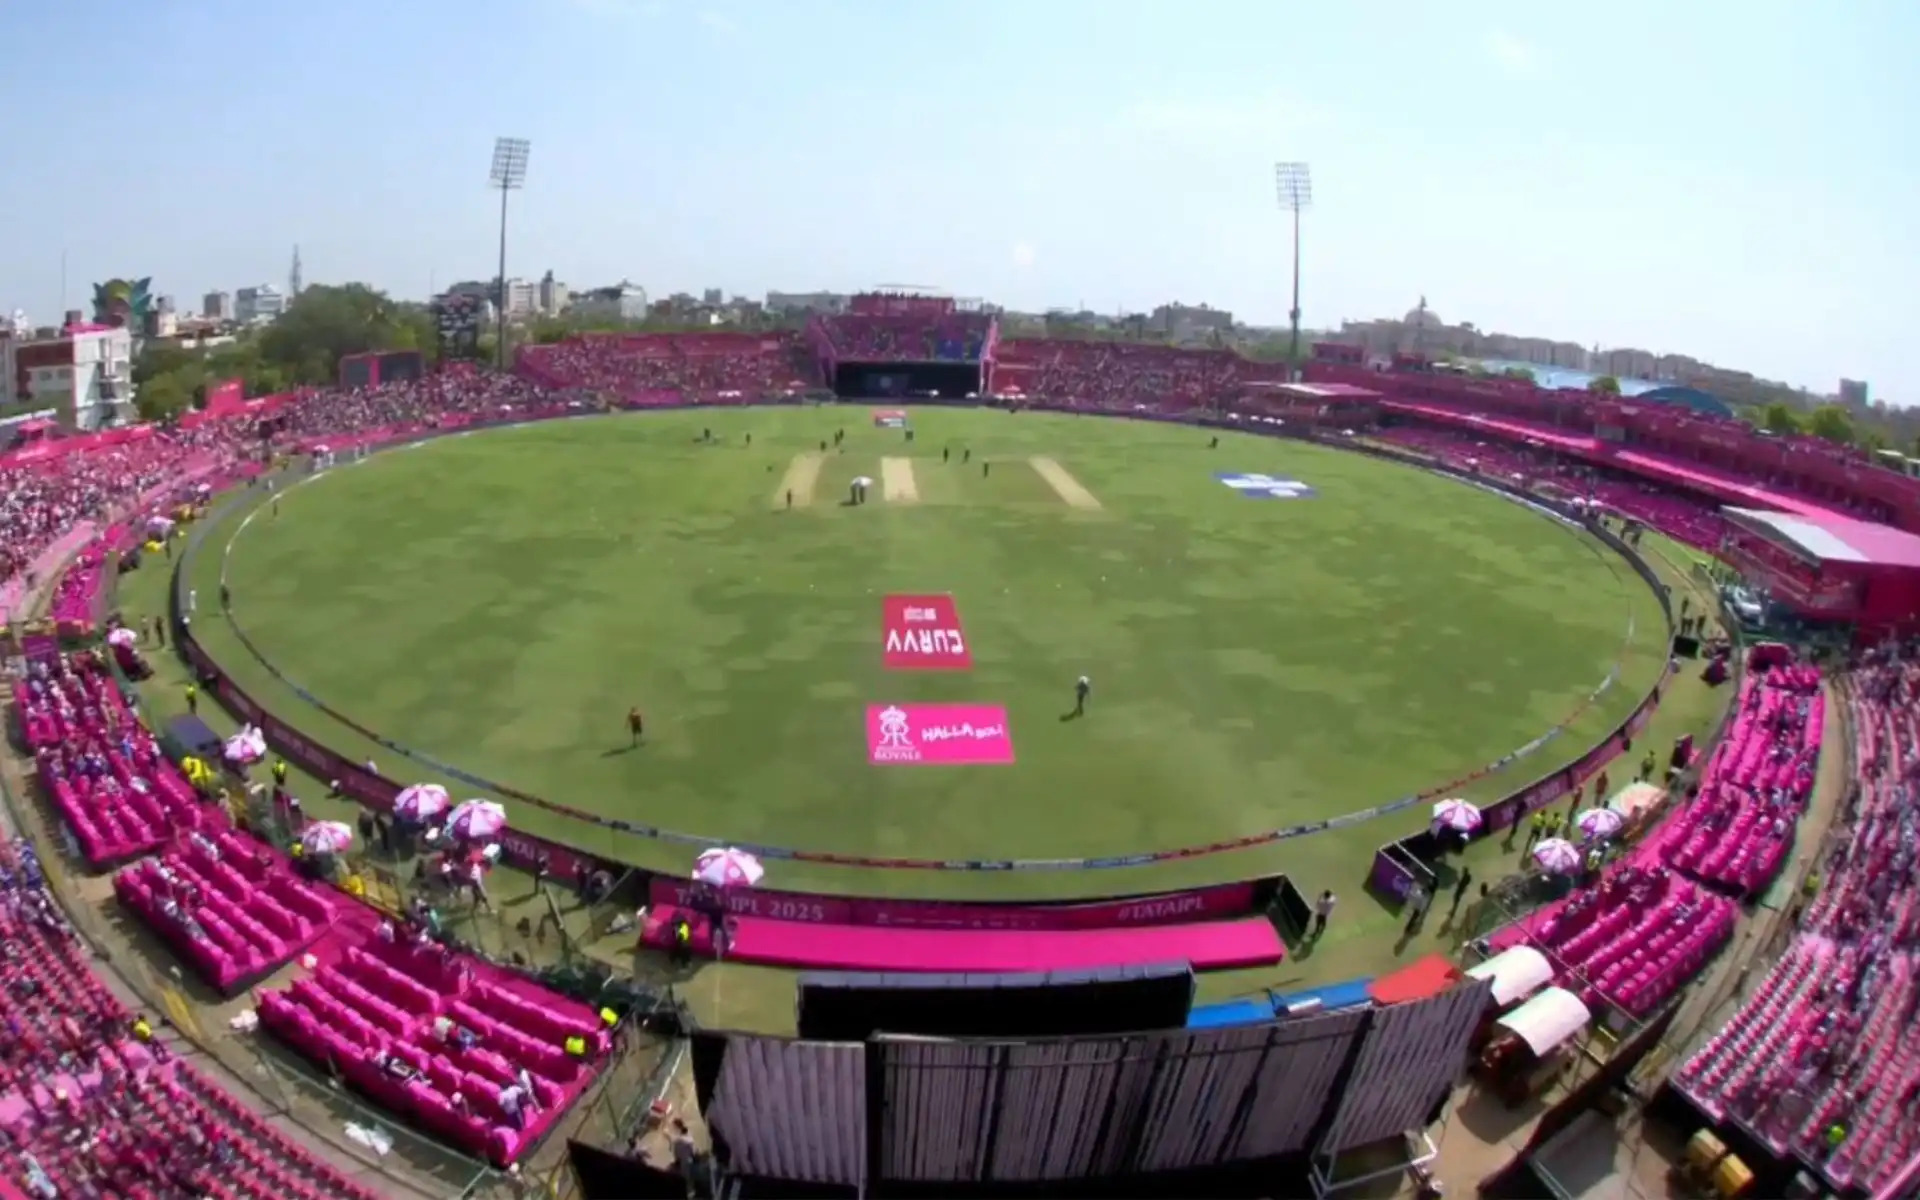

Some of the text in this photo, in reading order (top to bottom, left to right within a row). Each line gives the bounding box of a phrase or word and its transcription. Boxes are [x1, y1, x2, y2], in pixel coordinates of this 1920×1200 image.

[886, 629, 964, 654] CURVV
[921, 722, 974, 742] HALLA
[769, 902, 825, 921] 2025
